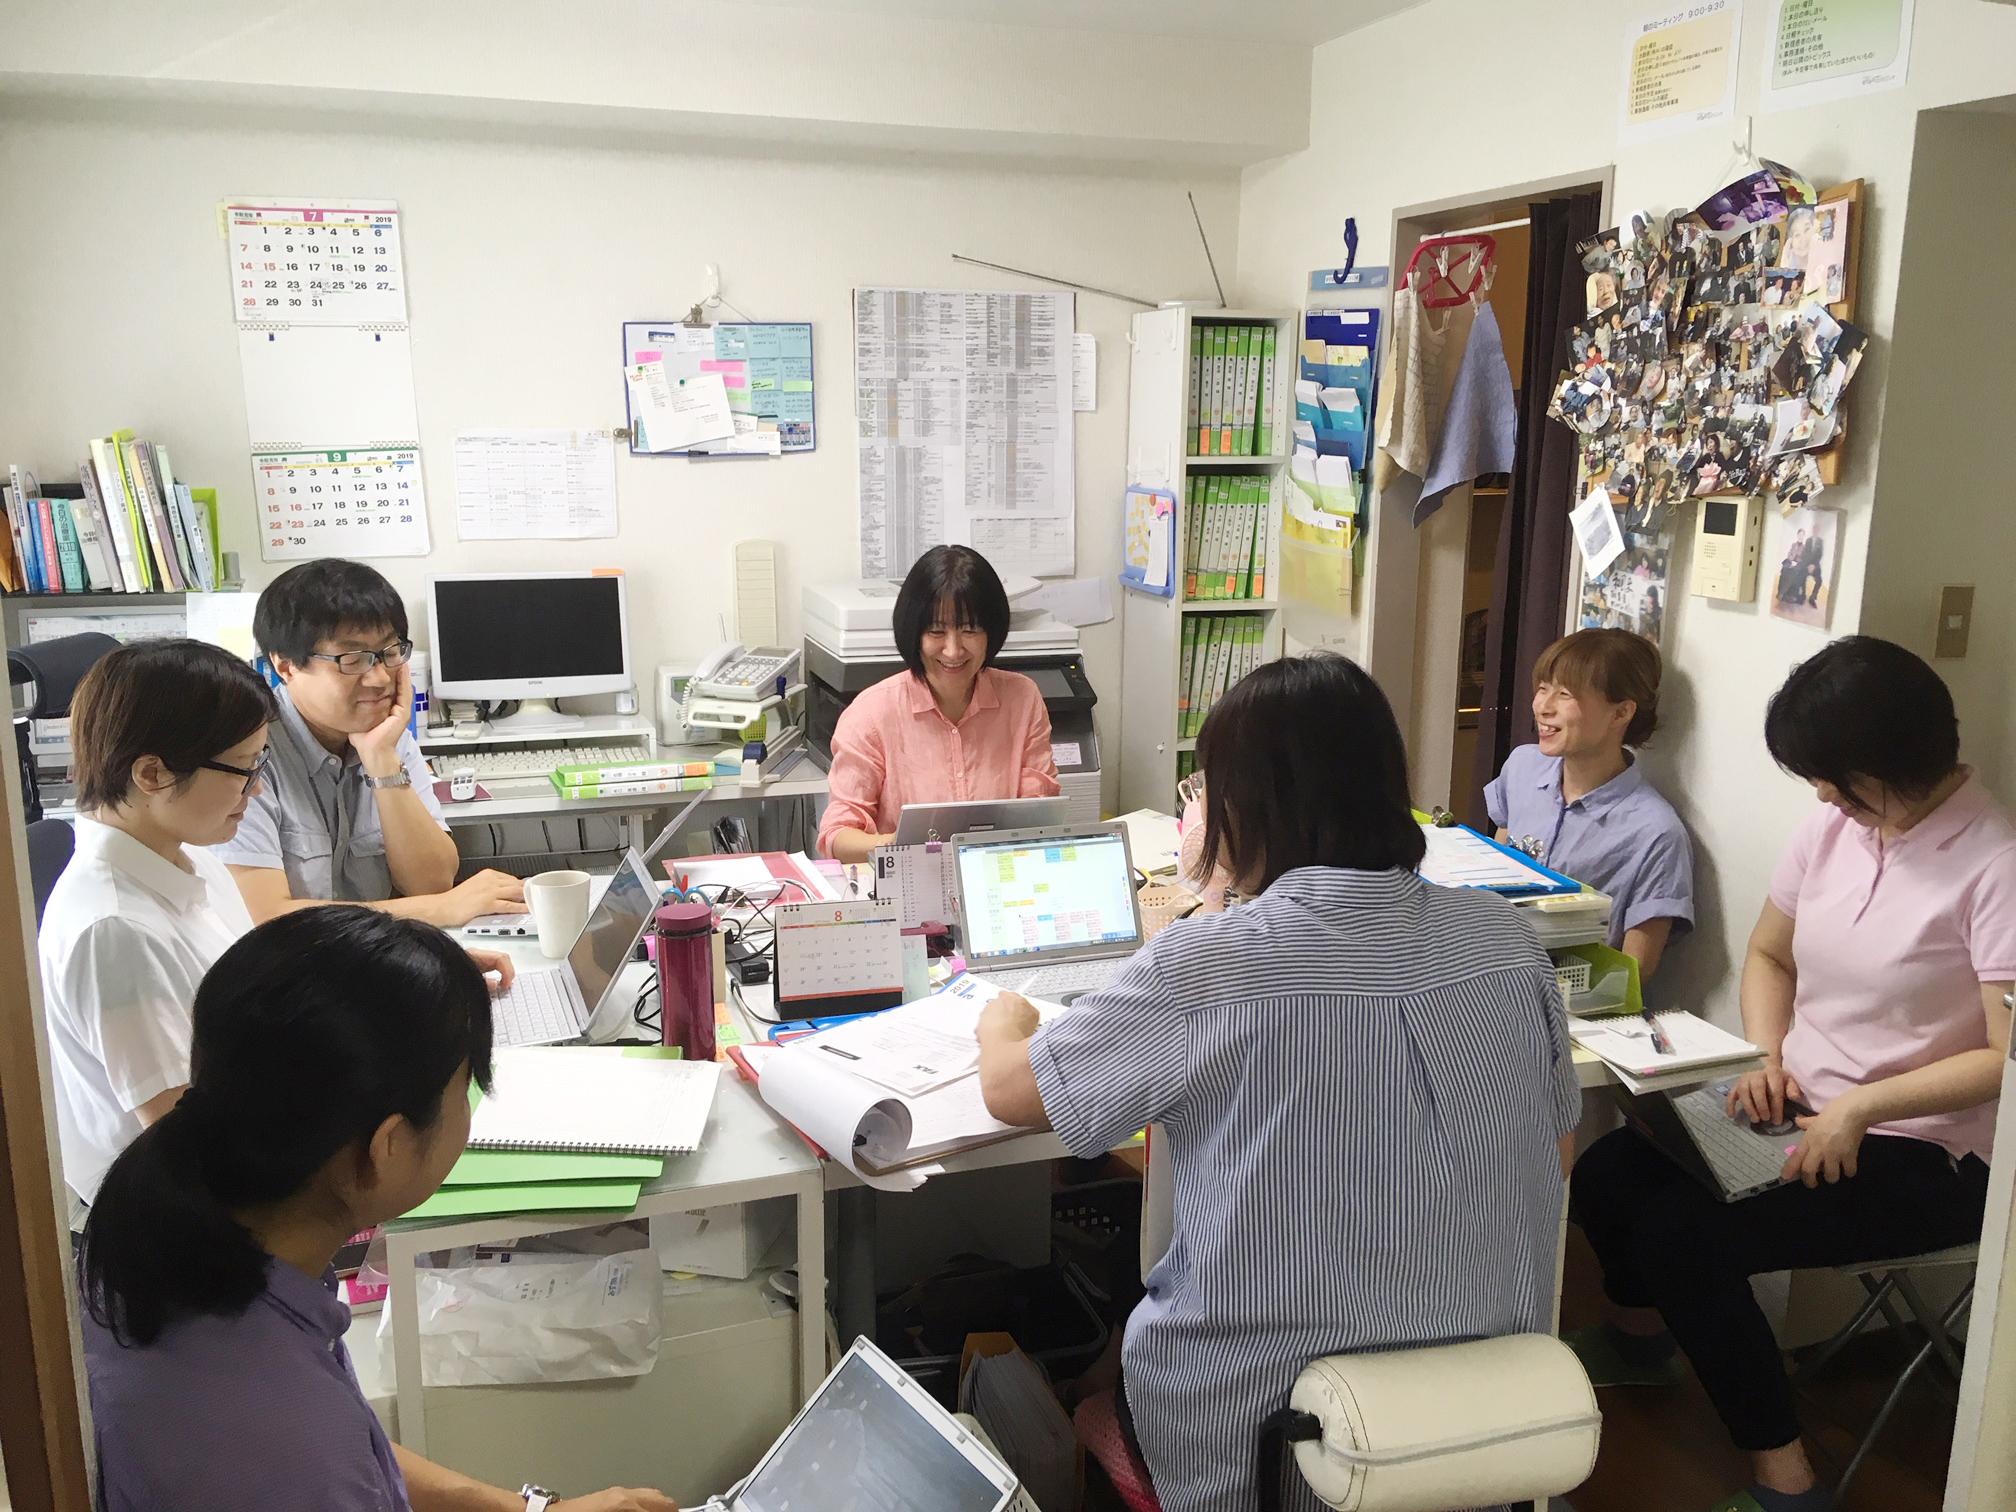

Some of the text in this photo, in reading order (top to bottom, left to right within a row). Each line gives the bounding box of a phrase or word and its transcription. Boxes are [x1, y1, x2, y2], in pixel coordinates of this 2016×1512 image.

[309, 212, 317, 221] 7
[264, 226, 268, 234] 1
[284, 226, 292, 234] 2
[308, 228, 314, 236] 3
[352, 228, 360, 236] 5
[374, 228, 382, 236] 6
[240, 244, 248, 252] 7
[264, 244, 270, 252] 8
[308, 246, 320, 254] 10
[352, 246, 364, 254] 12
[374, 246, 386, 254] 13
[240, 262, 252, 270] 14
[264, 262, 276, 270] 15
[332, 264, 344, 272] 18
[374, 264, 388, 272] 20
[242, 280, 252, 288] 21
[264, 280, 276, 288] 22
[286, 280, 300, 288] 23
[332, 282, 344, 290] 25
[354, 282, 368, 290] 26
[244, 298, 256, 306] 28
[288, 298, 302, 306] 30
[312, 298, 322, 306] 31
[333, 453, 342, 462] 9
[266, 470, 270, 478] 1
[288, 470, 294, 478] 2
[396, 464, 404, 472] 7
[268, 488, 276, 496] 8
[396, 482, 408, 490] 14
[268, 504, 280, 512] 15
[290, 504, 302, 512] 16
[270, 522, 282, 530] 22
[292, 520, 304, 528] 23
[272, 538, 284, 546] 29
[886, 856, 894, 868] 8
[835, 911, 842, 921] 8
[950, 980, 970, 994] 2019
